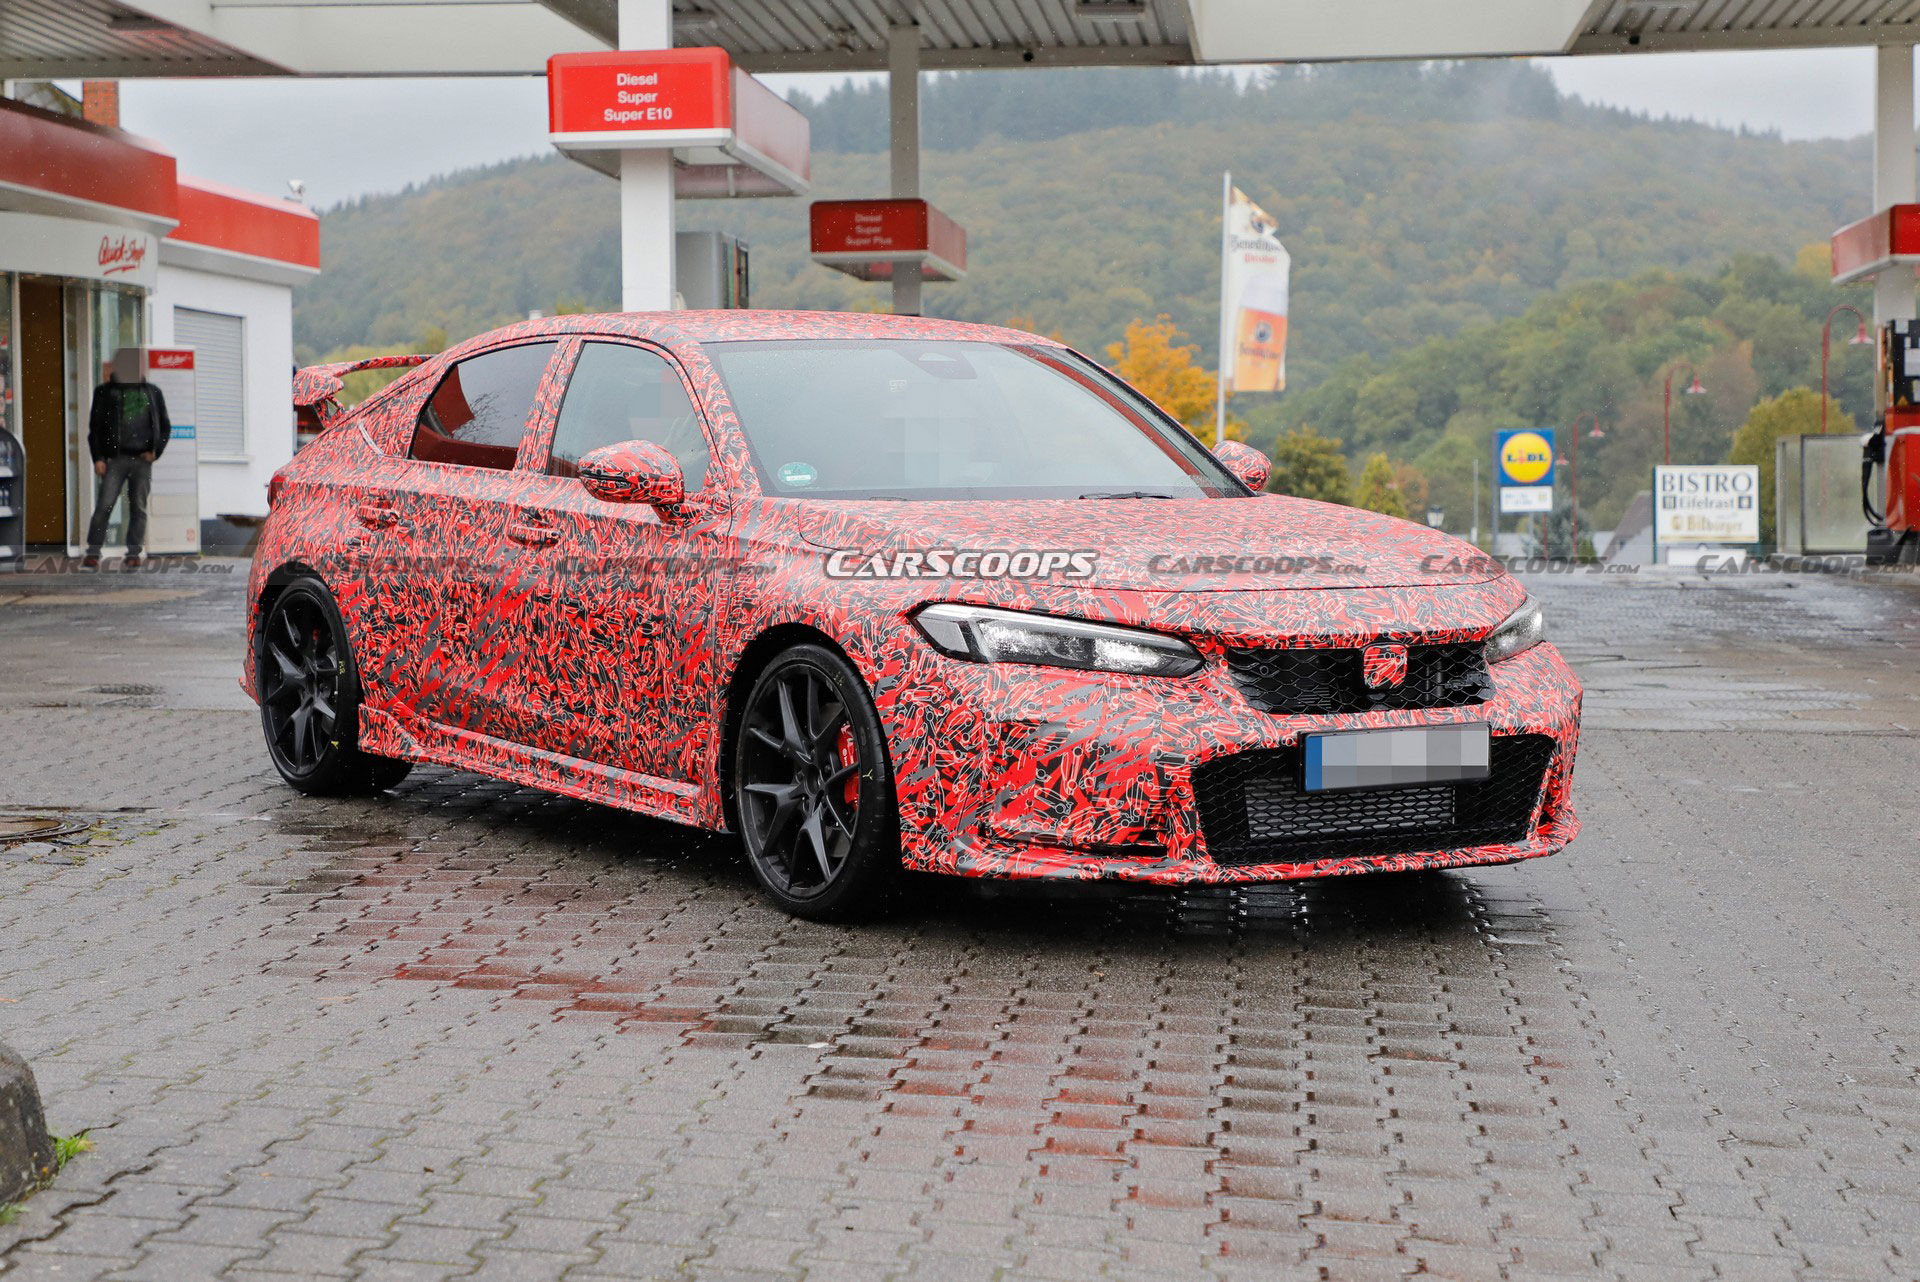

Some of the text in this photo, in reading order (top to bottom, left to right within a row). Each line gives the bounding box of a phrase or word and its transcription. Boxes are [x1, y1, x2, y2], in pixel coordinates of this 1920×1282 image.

[616, 72, 658, 87] Diesel
[617, 90, 658, 106] Super
[603, 106, 673, 124] Super E10
[855, 213, 883, 223] Diesel
[855, 225, 882, 235] Super
[846, 235, 892, 247] Super Plus
[170, 428, 195, 438] ermes
[1662, 472, 1752, 493] BISTRO
